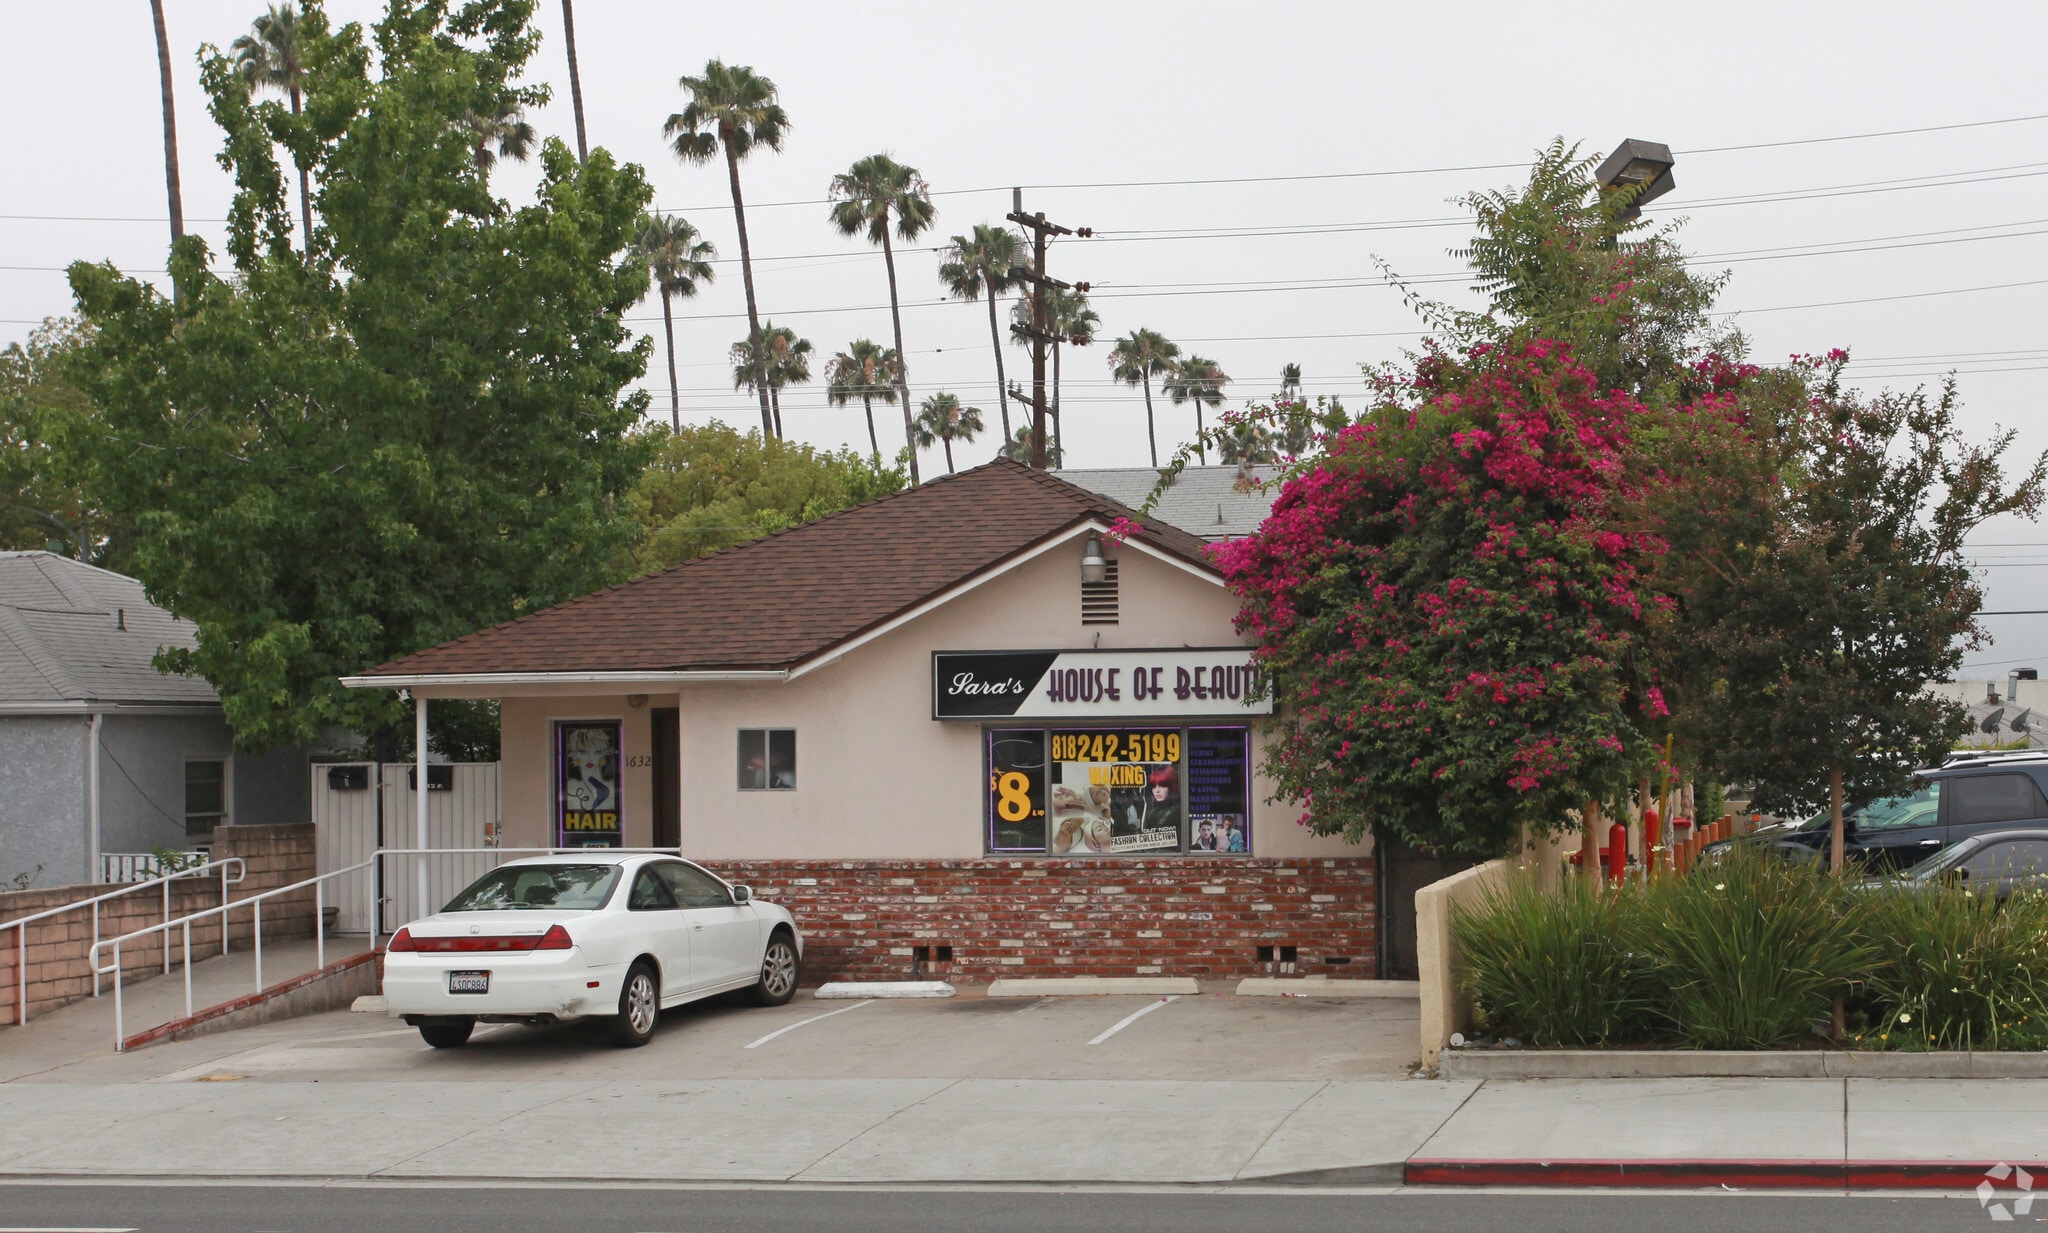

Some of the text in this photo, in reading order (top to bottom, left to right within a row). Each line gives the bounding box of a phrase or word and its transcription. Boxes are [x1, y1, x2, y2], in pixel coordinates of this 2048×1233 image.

[948, 672, 1025, 695] Sara's
[1046, 667, 1121, 703] HOUSE
[1133, 666, 1163, 701] OF
[1052, 733, 1180, 762] 818 242-5199
[626, 755, 651, 768] 1632
[1088, 765, 1144, 785] WAXING
[565, 812, 617, 830] HAIR
[1111, 831, 1176, 846] FASHION COLLECTION
